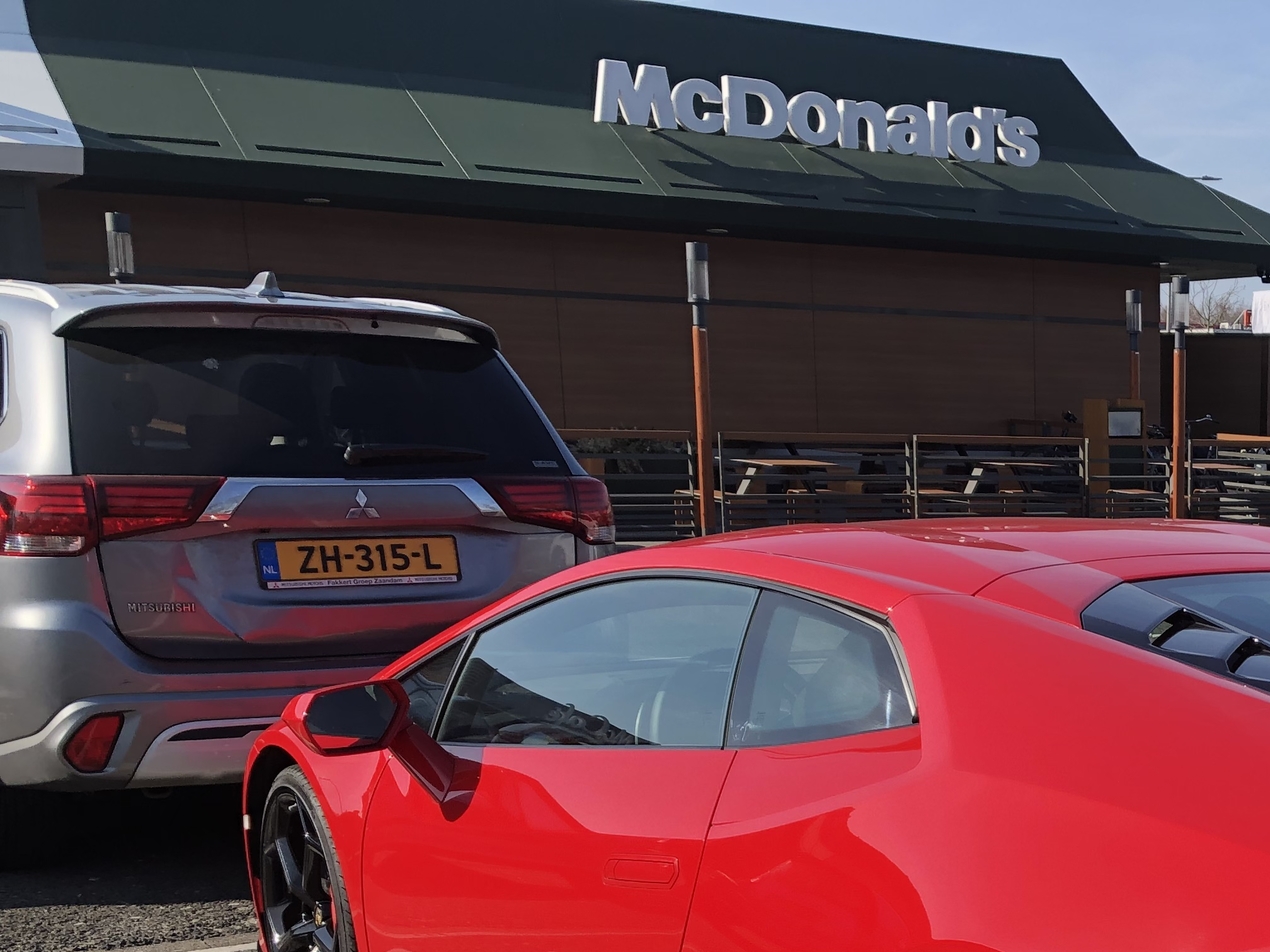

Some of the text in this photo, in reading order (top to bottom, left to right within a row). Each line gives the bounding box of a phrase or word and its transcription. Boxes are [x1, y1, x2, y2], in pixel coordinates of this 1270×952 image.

[593, 58, 1040, 167] McDonald's
[297, 543, 442, 574] ZH-315-L
[263, 565, 278, 575] NL
[353, 578, 373, 586] Groep
[127, 603, 196, 613] MITSUBISHI
